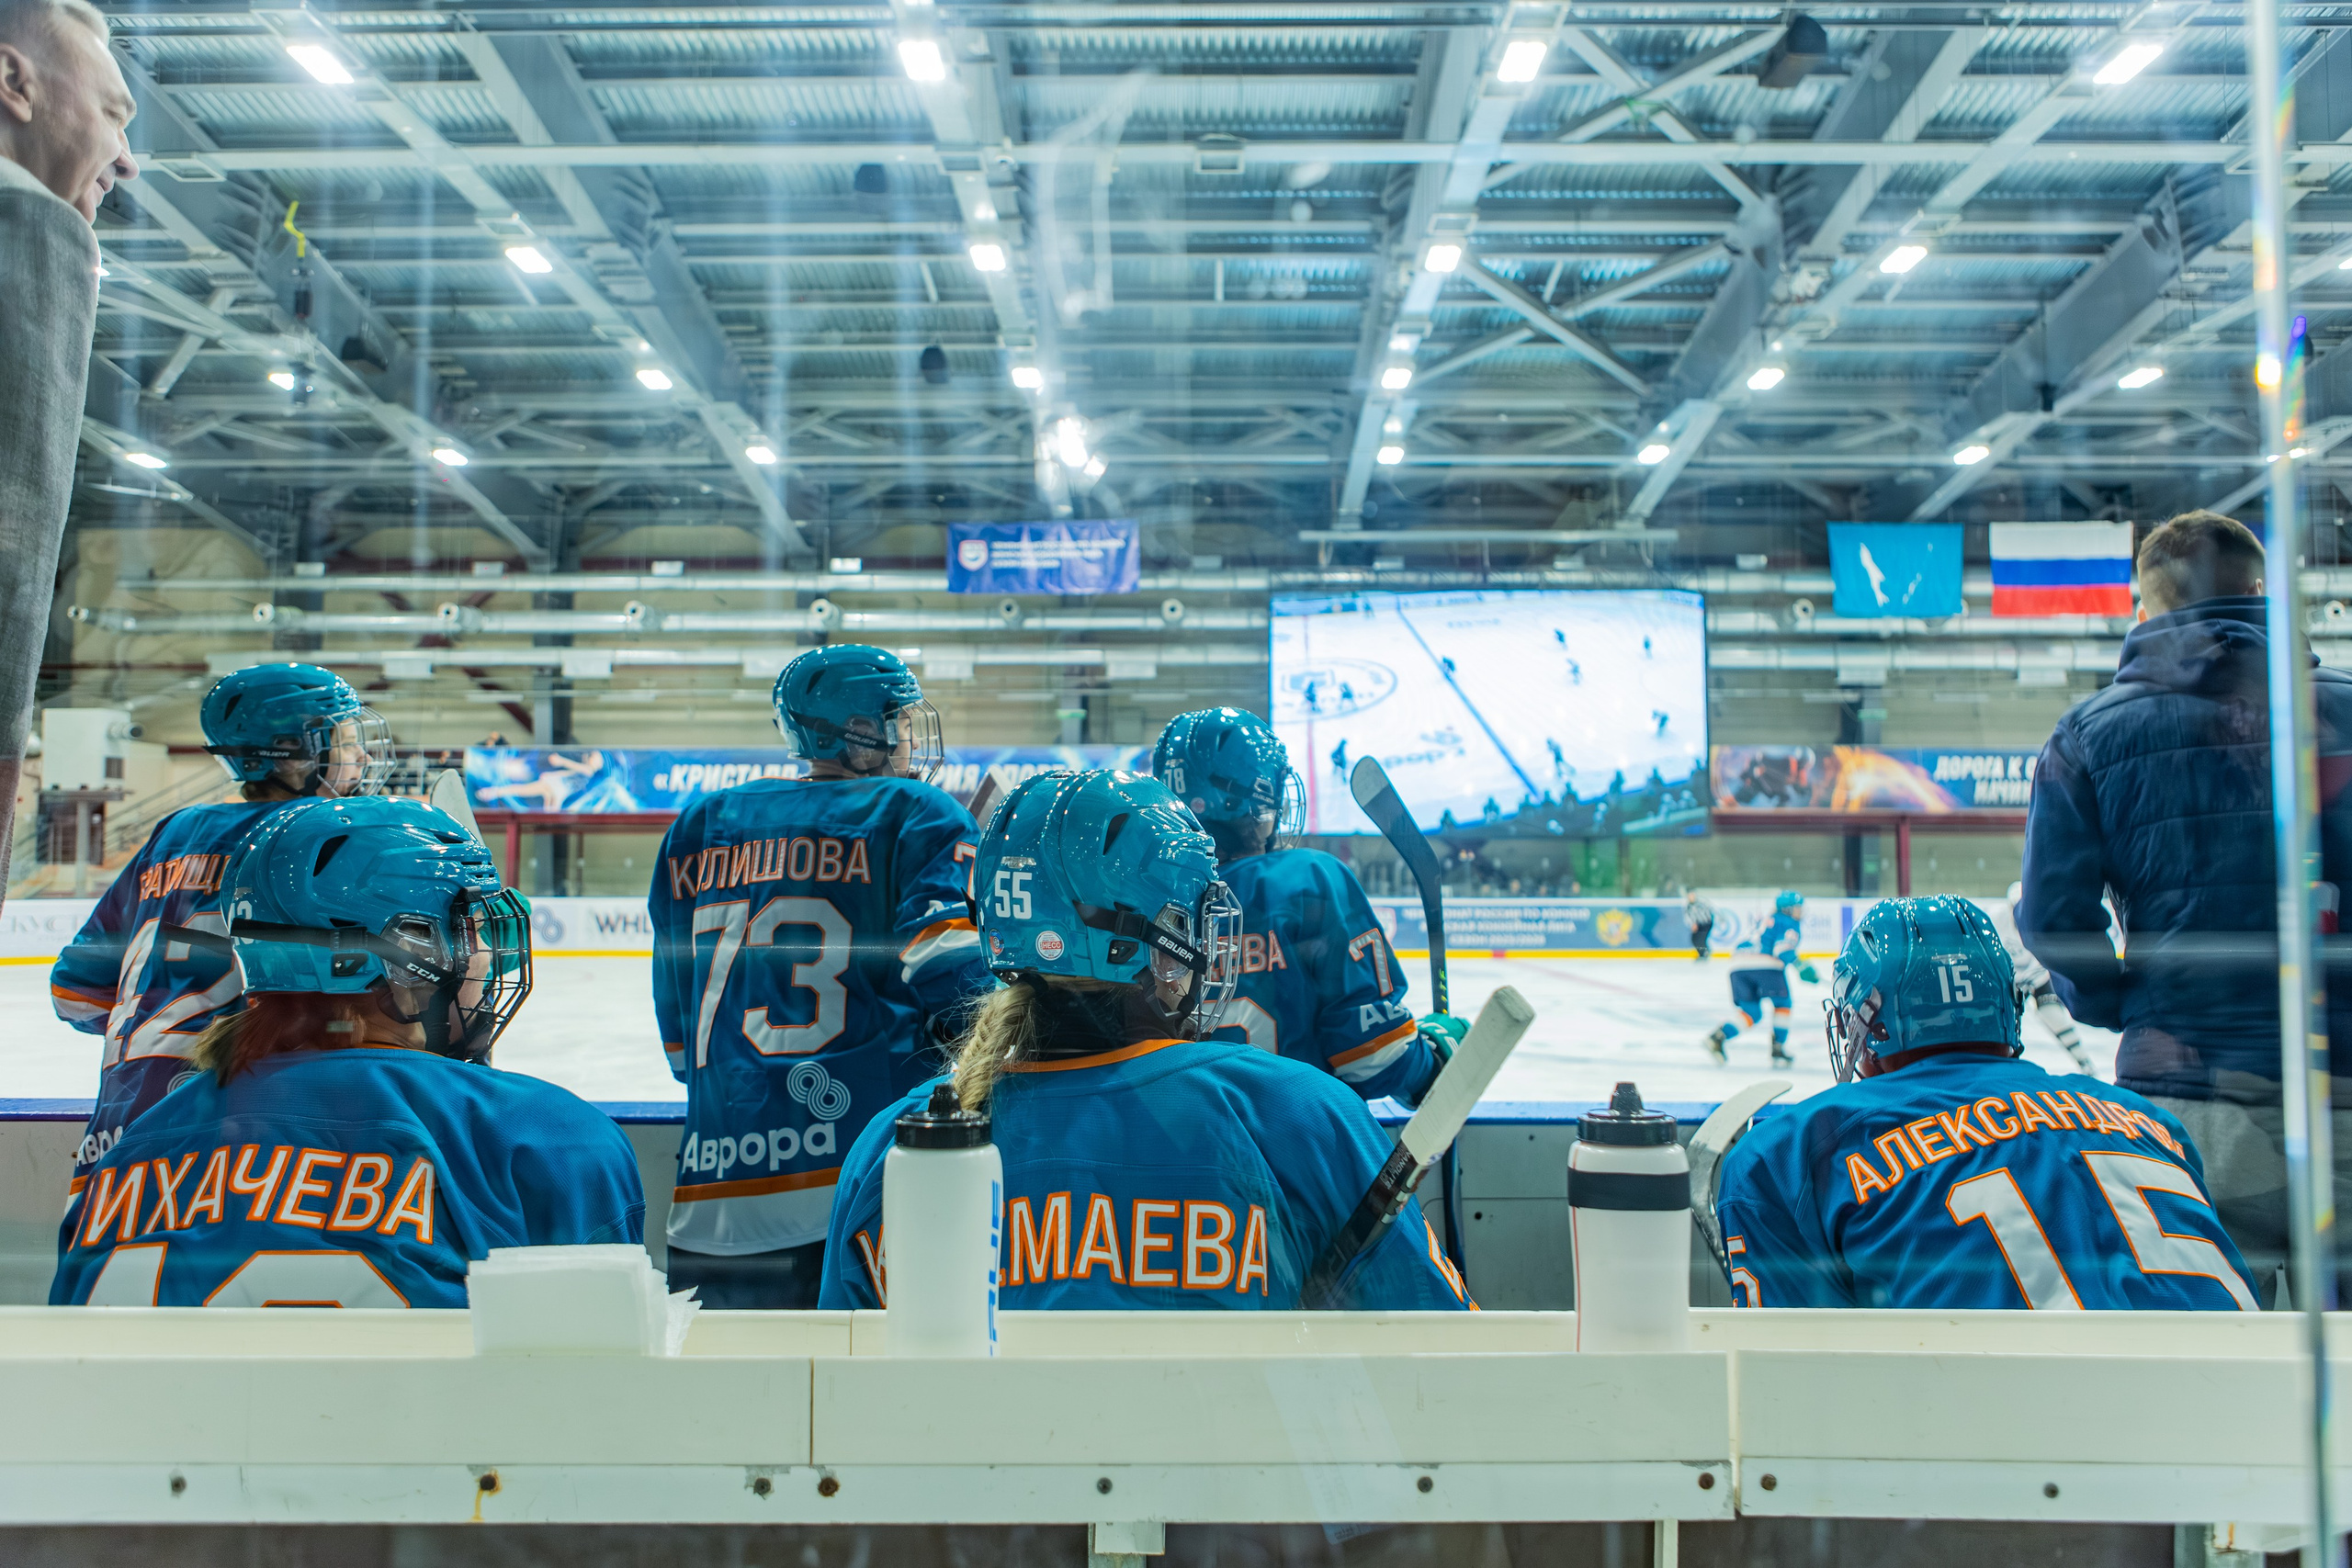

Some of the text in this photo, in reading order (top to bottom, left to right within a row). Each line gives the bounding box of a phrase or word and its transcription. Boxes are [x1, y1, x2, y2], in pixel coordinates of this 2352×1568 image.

[652, 763, 808, 793] «КРИСТАЛЛ
[668, 836, 872, 901] КУЛИШОВА
[994, 870, 1033, 919] 55
[406, 962, 441, 983] CCM
[1042, 942, 1062, 950] HECC
[1158, 935, 1194, 963] BAUER
[1349, 927, 1393, 997] 7
[692, 896, 854, 1069] 73
[1937, 964, 1974, 1003] 15
[682, 1122, 836, 1179] Аврора
[67, 1143, 435, 1254] ИХАЧЕВА
[1944, 1149, 2261, 1310] 15
